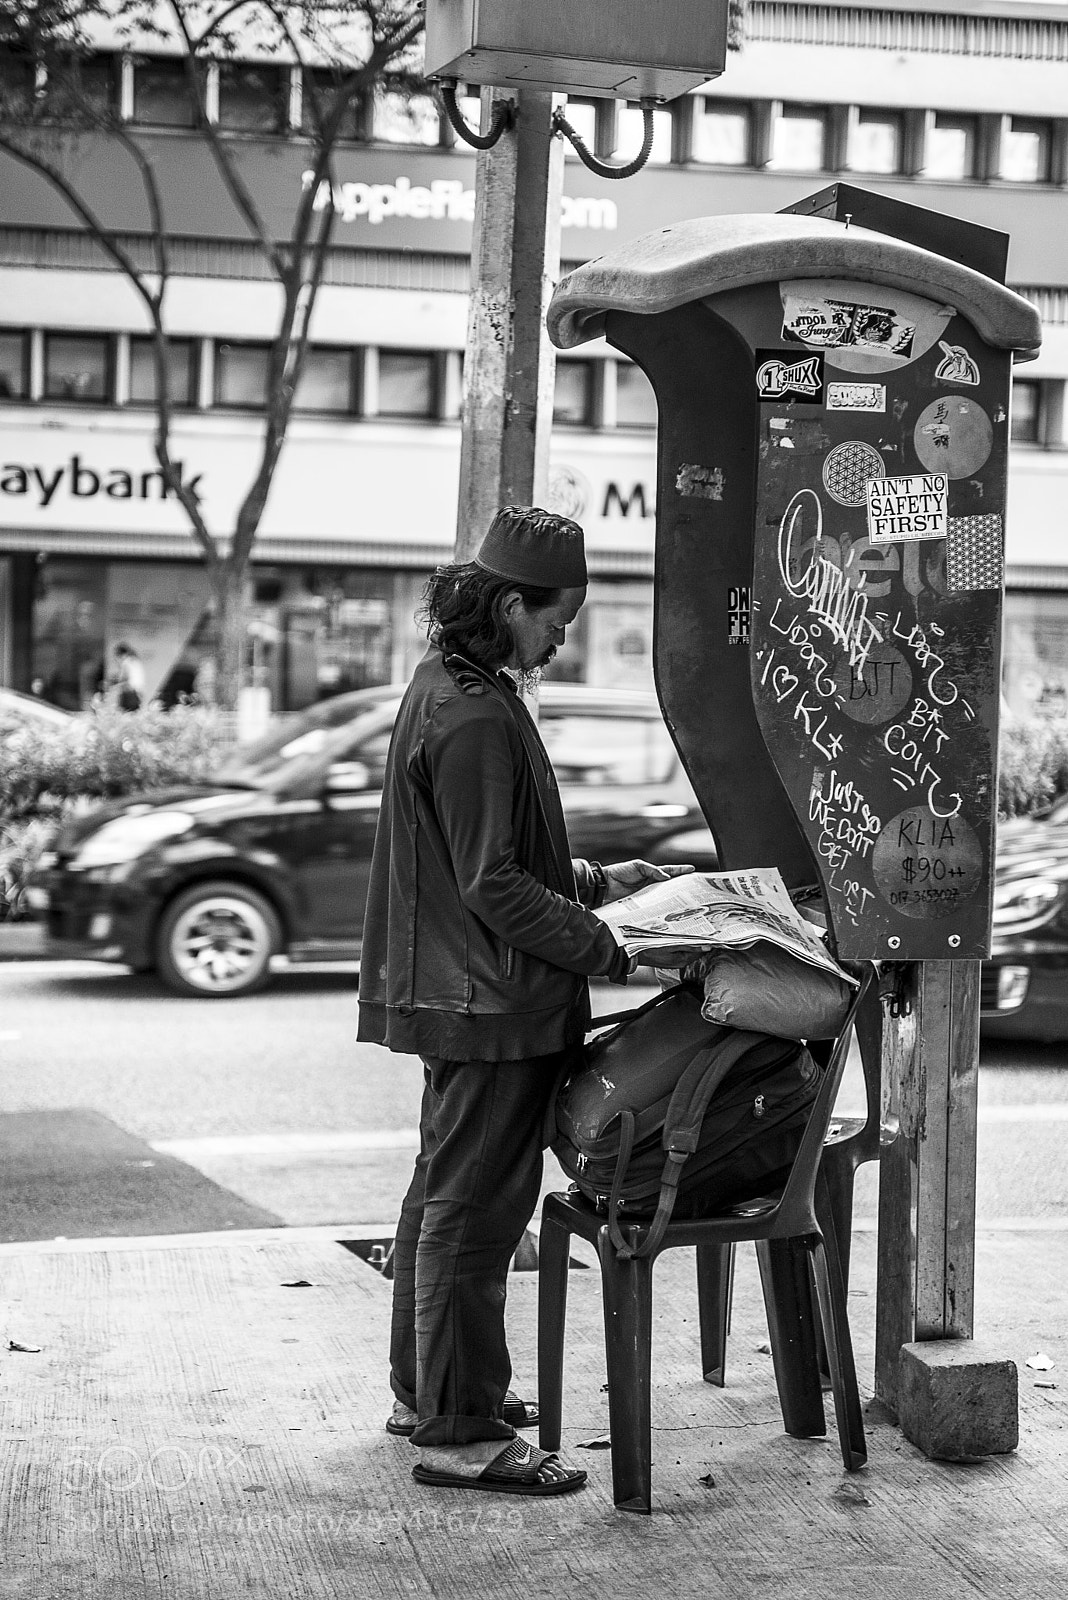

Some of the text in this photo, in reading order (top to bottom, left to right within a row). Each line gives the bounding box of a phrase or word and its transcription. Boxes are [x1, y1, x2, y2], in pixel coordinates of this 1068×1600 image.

[783, 363, 815, 384] SHUX
[870, 476, 945, 496] AIN'T NO
[871, 493, 944, 517] SAFETY
[874, 513, 943, 535] FIRST
[898, 818, 956, 849] KLIA
[818, 829, 852, 871] GET
